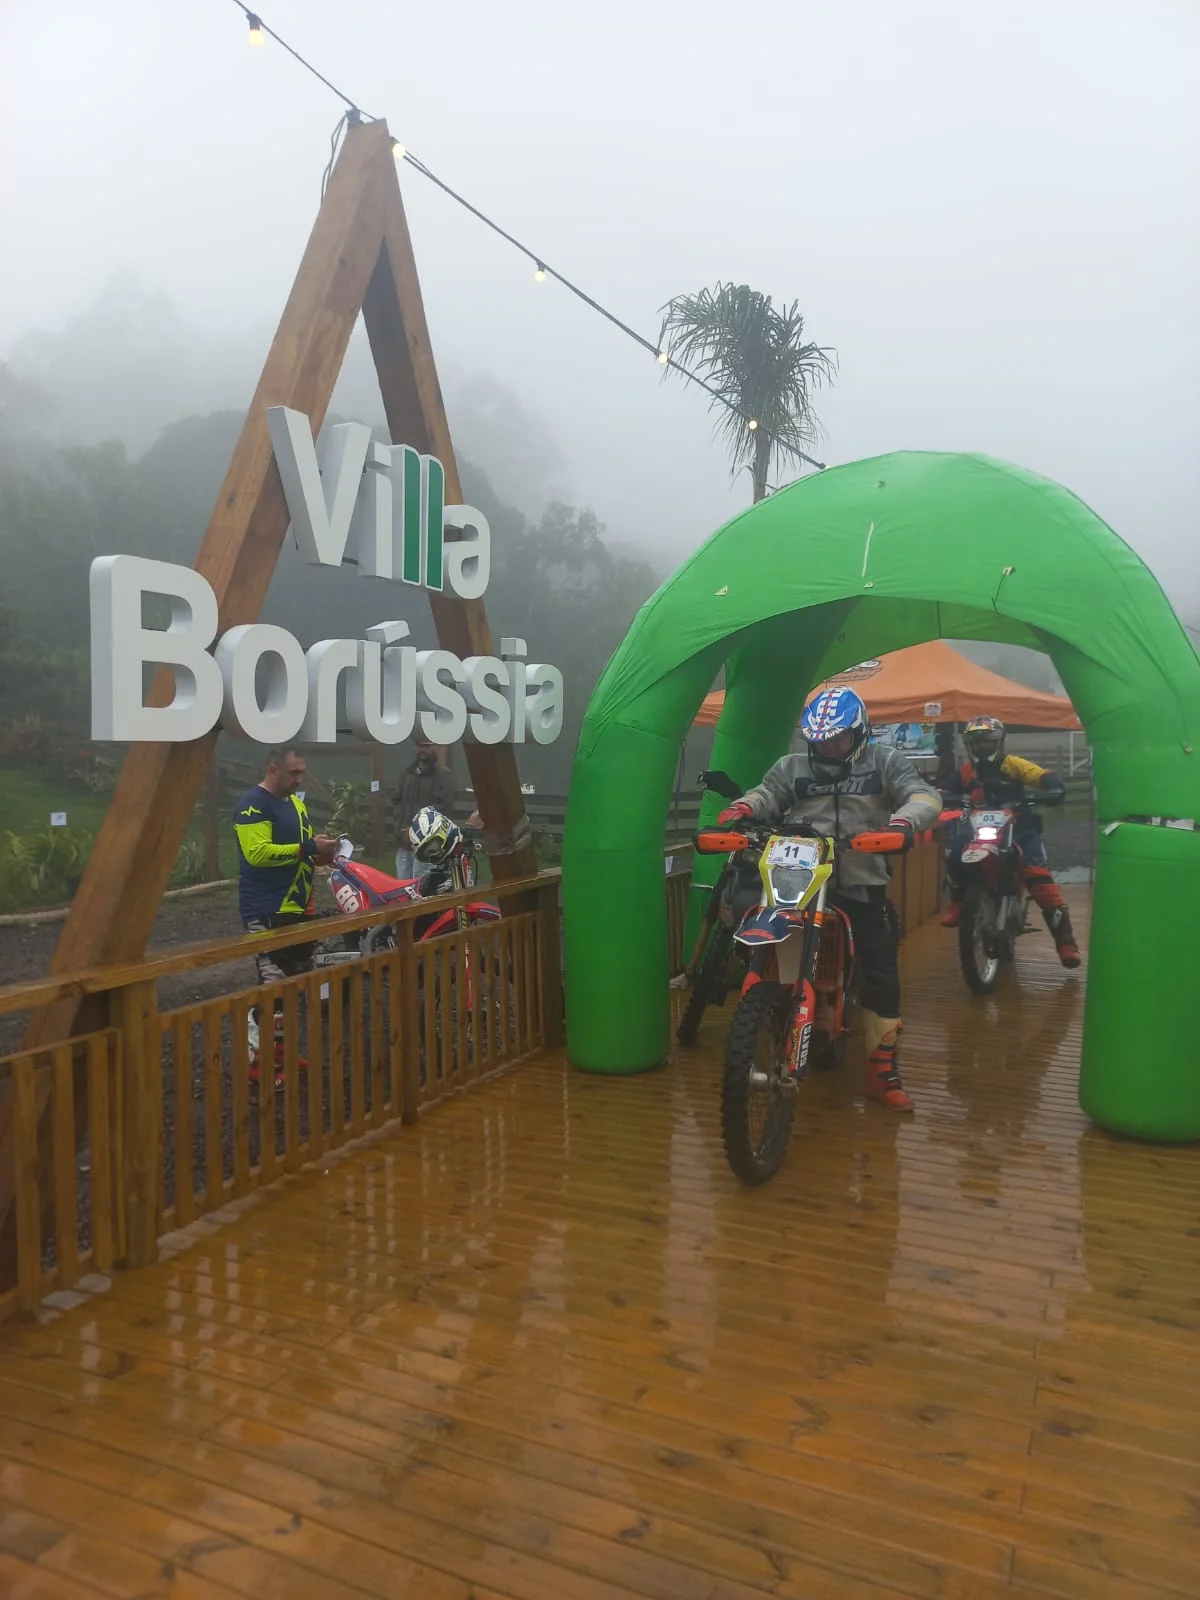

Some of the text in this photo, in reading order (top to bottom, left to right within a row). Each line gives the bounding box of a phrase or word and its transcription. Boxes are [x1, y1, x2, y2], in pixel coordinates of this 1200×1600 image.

[266, 405, 491, 600] Villa
[89, 554, 564, 745] Borússia
[784, 845, 800, 859] 11
